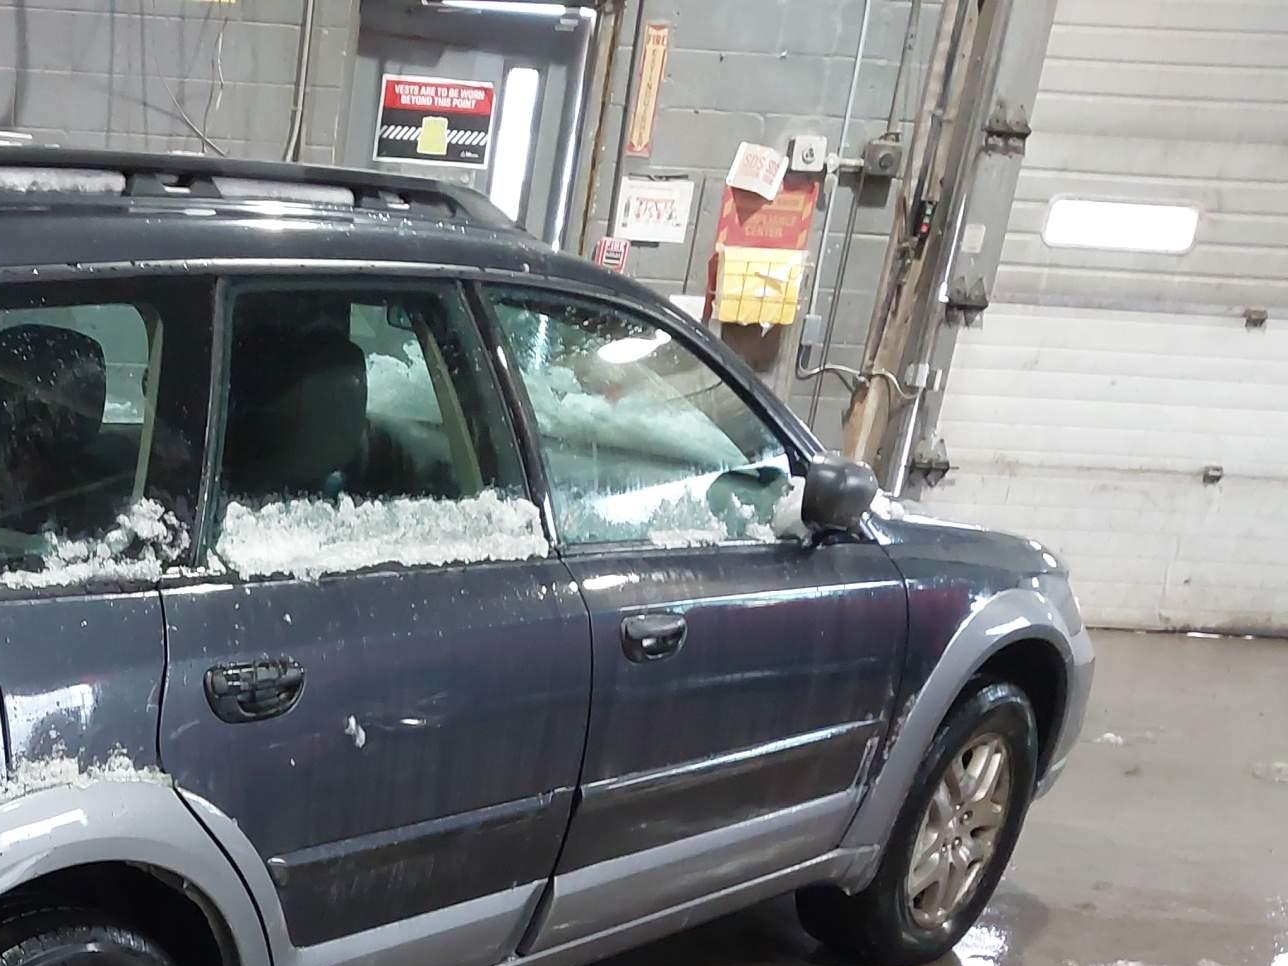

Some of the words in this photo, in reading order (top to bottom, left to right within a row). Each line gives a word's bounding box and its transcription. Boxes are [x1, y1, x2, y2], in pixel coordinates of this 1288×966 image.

[394, 84, 419, 95] VESTS
[420, 86, 436, 97] ARE
[437, 87, 448, 98] TO
[449, 88, 459, 98] BE
[460, 88, 486, 101] WORN
[400, 94, 433, 106] BEYOND
[434, 96, 452, 107] THIS
[453, 97, 477, 110] POINT
